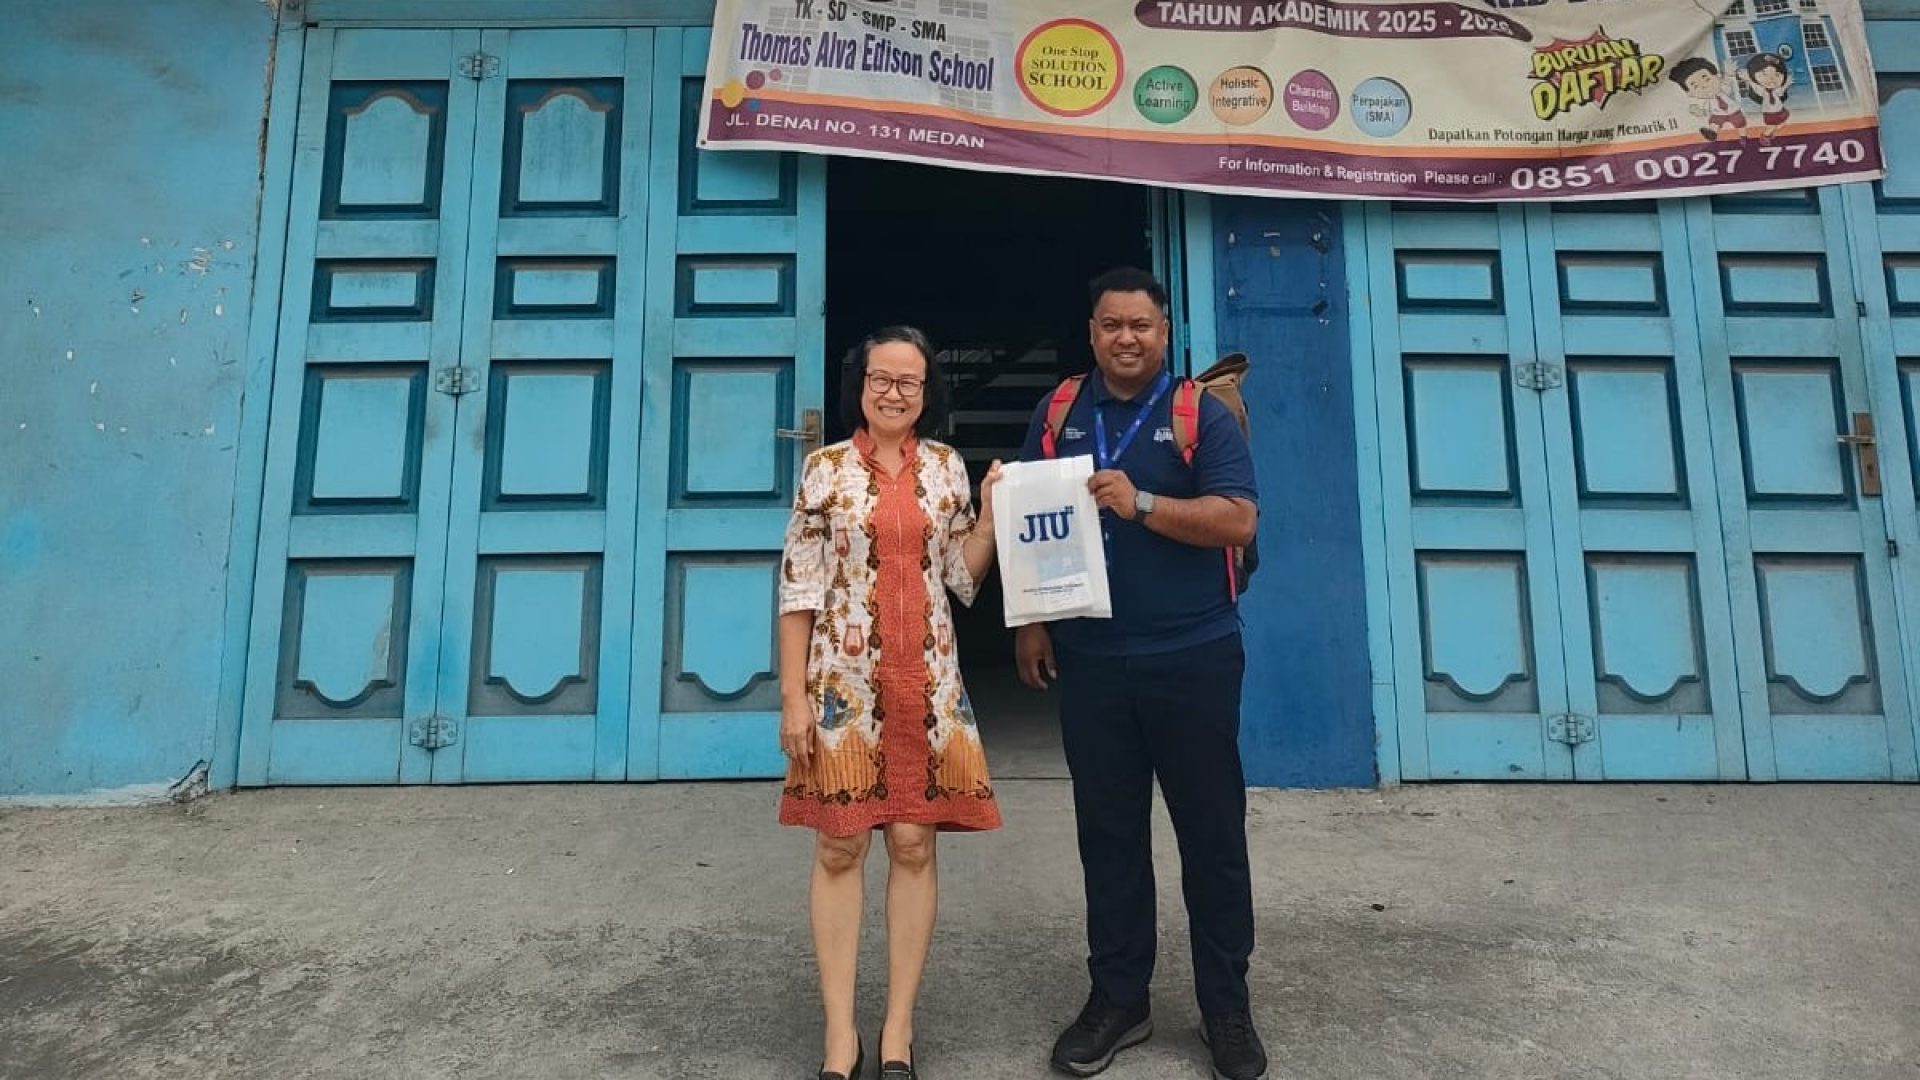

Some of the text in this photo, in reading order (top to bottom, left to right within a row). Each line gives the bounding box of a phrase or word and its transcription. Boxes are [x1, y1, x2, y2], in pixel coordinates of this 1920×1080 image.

[827, 0, 847, 22] SD
[861, 10, 896, 32] SMP
[911, 20, 947, 42] SMA
[1157, 3, 1241, 25] TAHUN
[1250, 1, 1369, 31] AKADEMIK
[1377, 10, 1436, 33] 2025
[740, 23, 995, 91] Thomas Alva Edison School
[1042, 46, 1099, 60] One Stop
[1533, 39, 1636, 78] BURUAN
[1031, 58, 1107, 73] SOLUTION
[1028, 72, 1108, 91] SCHOOL
[1146, 78, 1184, 92] Active
[1220, 77, 1259, 89] Holistic
[1531, 54, 1664, 120] DAFTAR
[1212, 94, 1268, 109] Integrative
[1289, 83, 1334, 101] Character
[1352, 94, 1406, 108] Perpajakan
[1138, 95, 1190, 113] Learning
[1292, 100, 1331, 119] Building
[1365, 110, 1395, 123] (SMA)
[725, 114, 986, 149] JL. DENAI NO. 131 MEDAN
[1428, 128, 1490, 142] Dapatkan
[1494, 128, 1553, 144] Potongan
[1557, 128, 1590, 142] Harga
[1590, 127, 1615, 141] yang
[1616, 119, 1666, 137] Menarik
[1218, 156, 1243, 170] For
[1245, 158, 1321, 177] Information
[1324, 165, 1334, 178] &
[1336, 166, 1417, 185] Registration
[1424, 170, 1470, 185] Please
[1472, 173, 1496, 185] call
[1510, 163, 1617, 191] 0851
[1634, 149, 1743, 183] 0027
[1758, 139, 1866, 172] 7740
[1018, 512, 1072, 543] JIU
